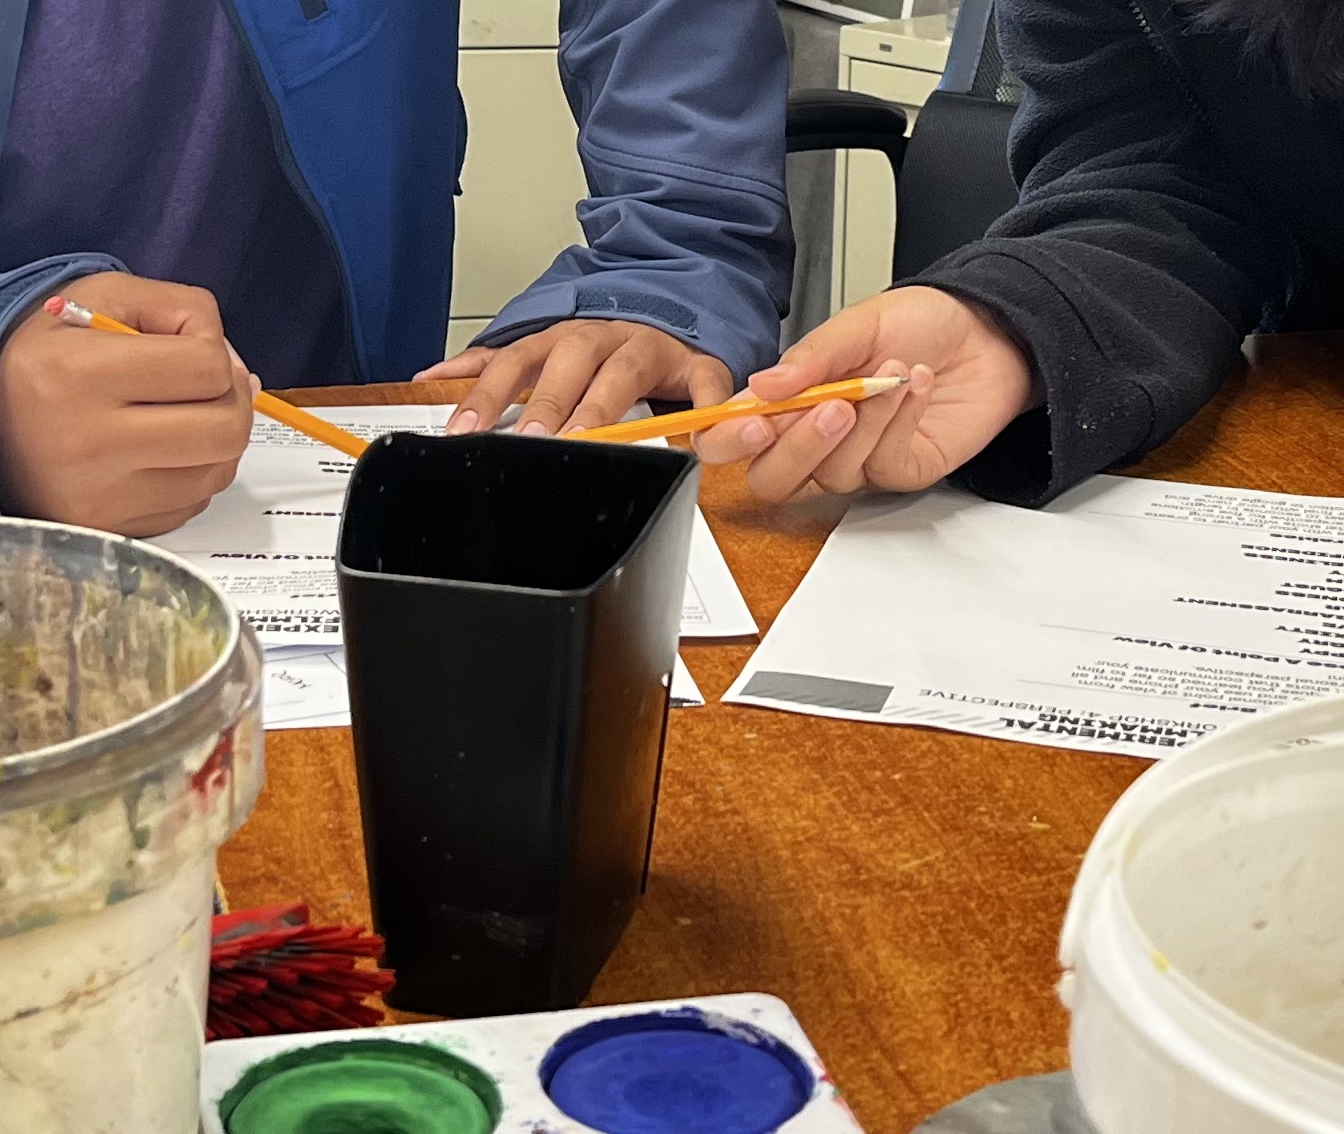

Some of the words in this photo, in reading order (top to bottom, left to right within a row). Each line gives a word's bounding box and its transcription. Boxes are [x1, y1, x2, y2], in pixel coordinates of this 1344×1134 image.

[1113, 636, 1174, 649] View
[1212, 649, 1279, 663] Point
[918, 688, 1072, 716] PERSPECTIVE
[1229, 697, 1287, 706] otional
[1108, 715, 1217, 732] ORKSHOP
[997, 717, 1184, 748] ERIMENTAL
